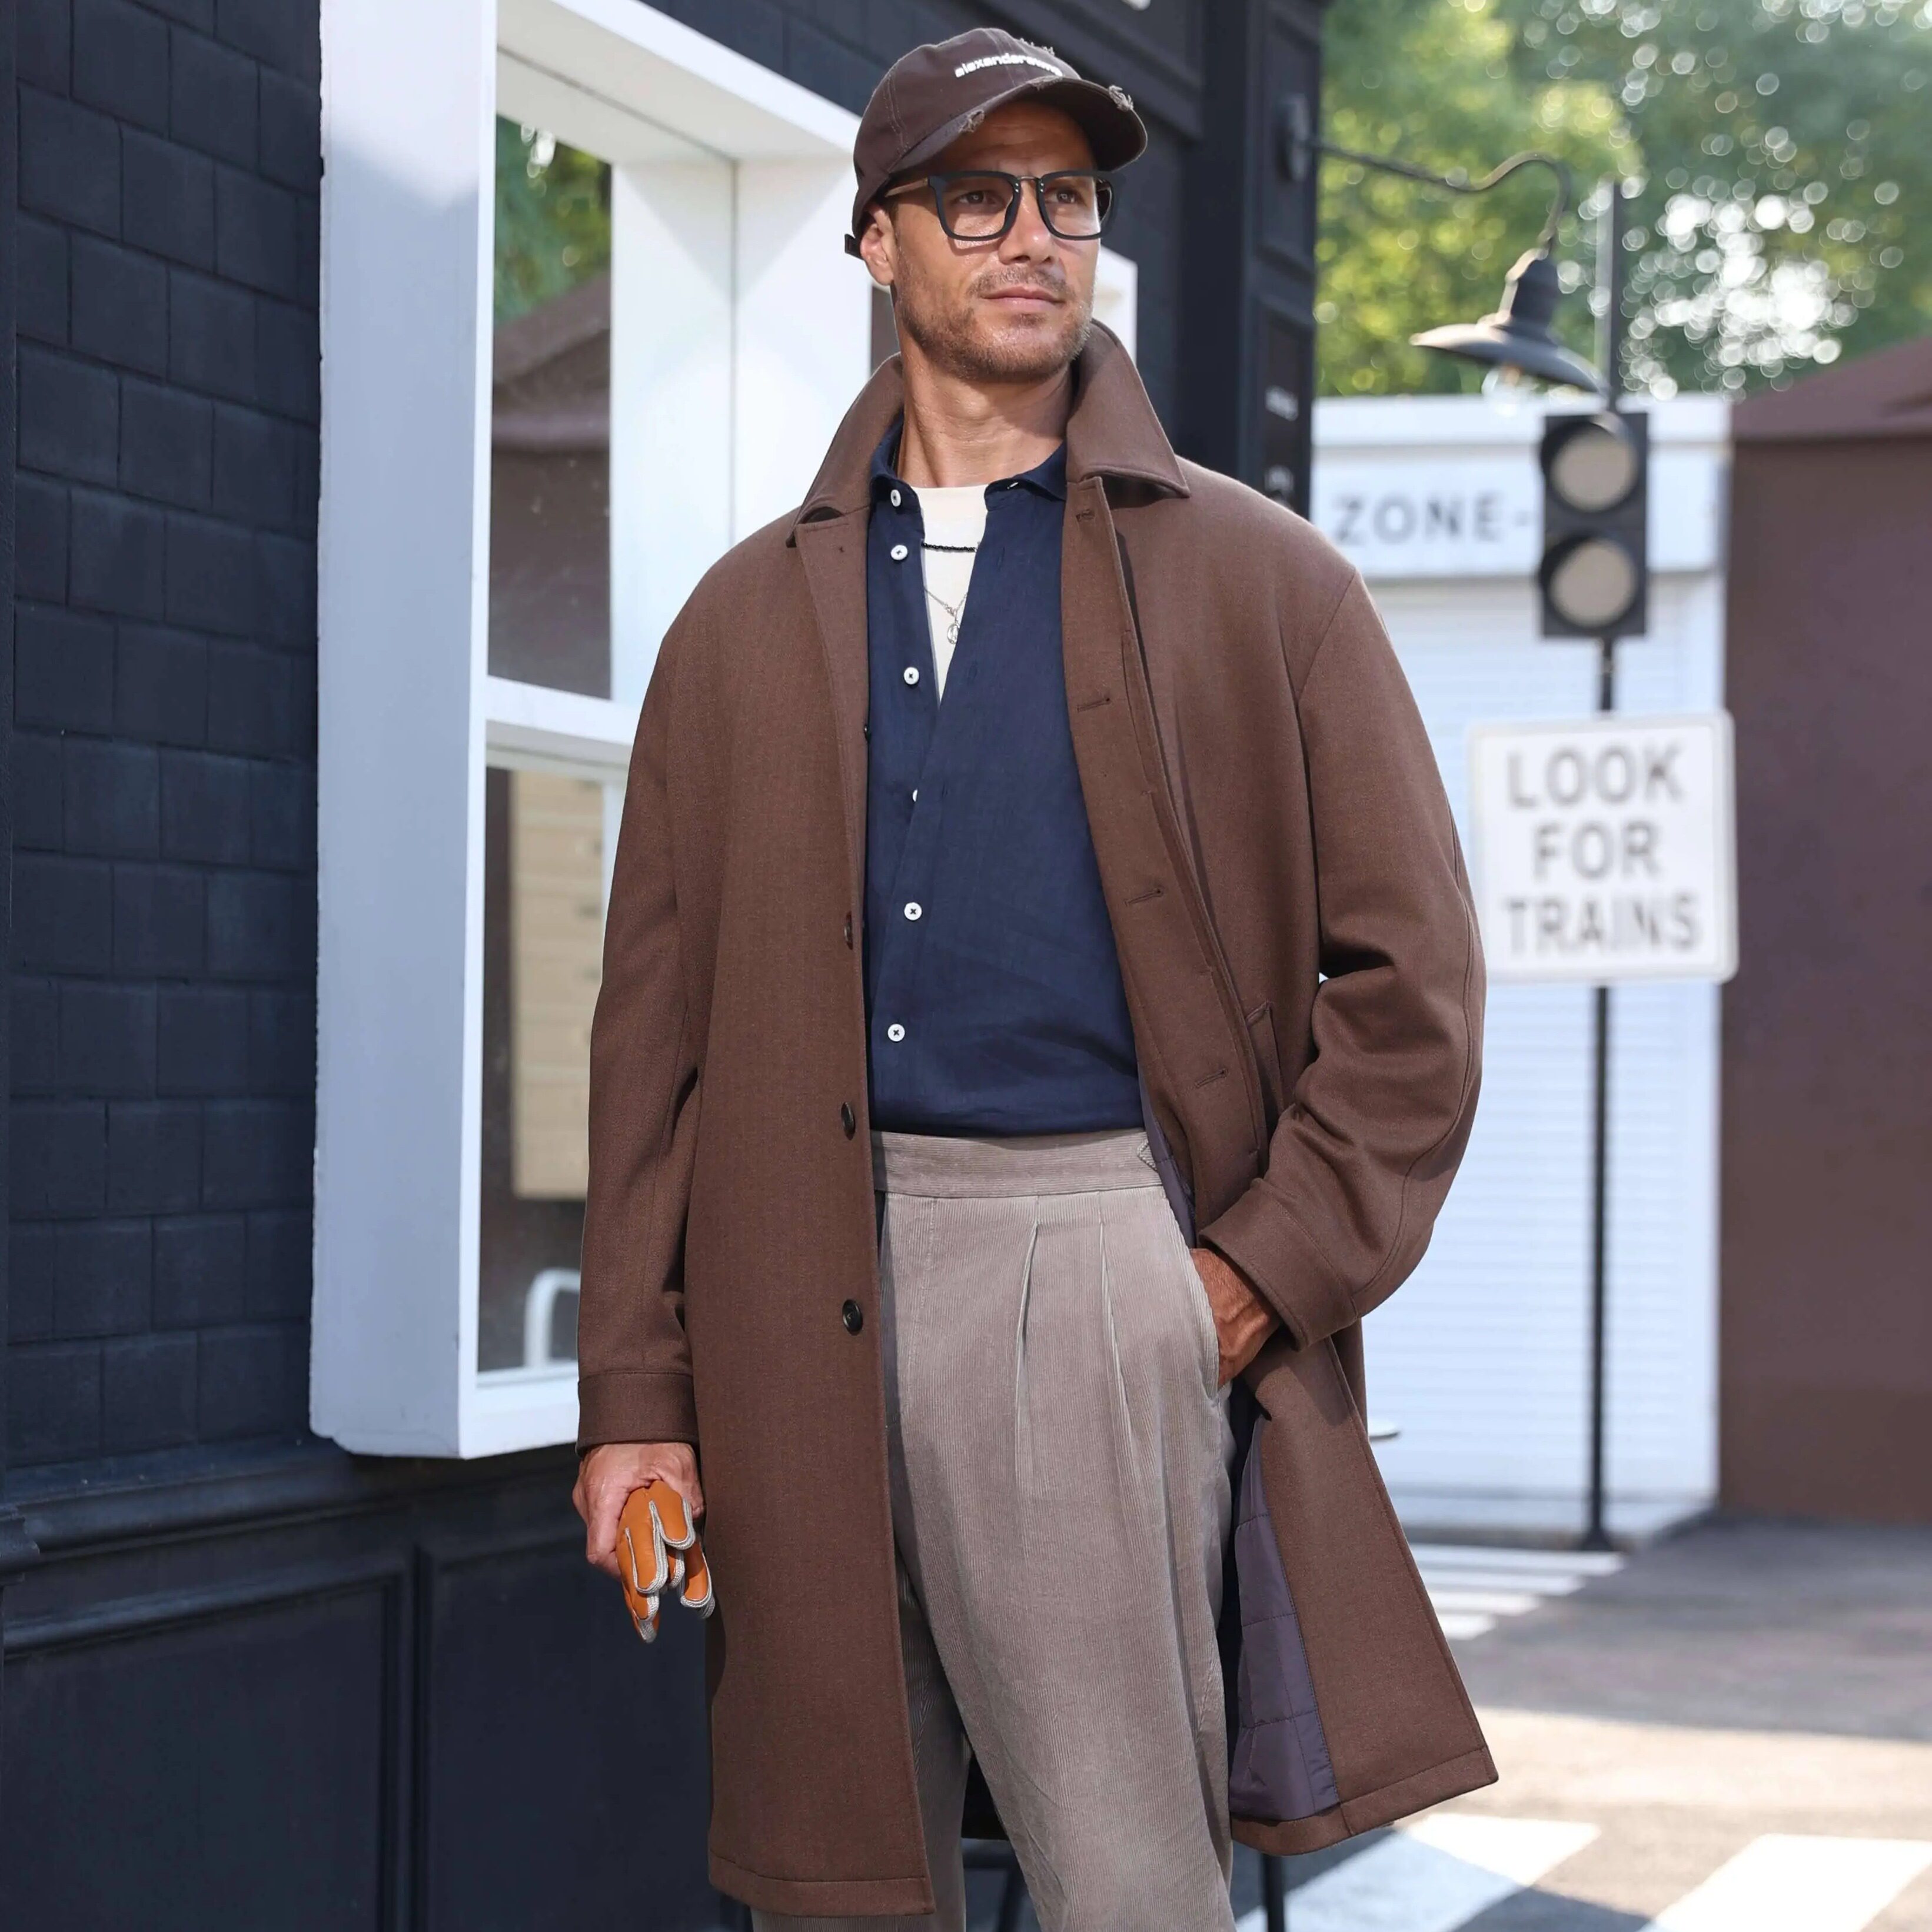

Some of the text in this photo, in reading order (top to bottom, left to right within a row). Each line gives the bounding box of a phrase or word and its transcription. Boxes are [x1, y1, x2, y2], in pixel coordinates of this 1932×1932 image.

[1508, 744, 1682, 807] LOOK
[1534, 819, 1661, 880] FOR
[1504, 893, 1697, 955] TRAINS
